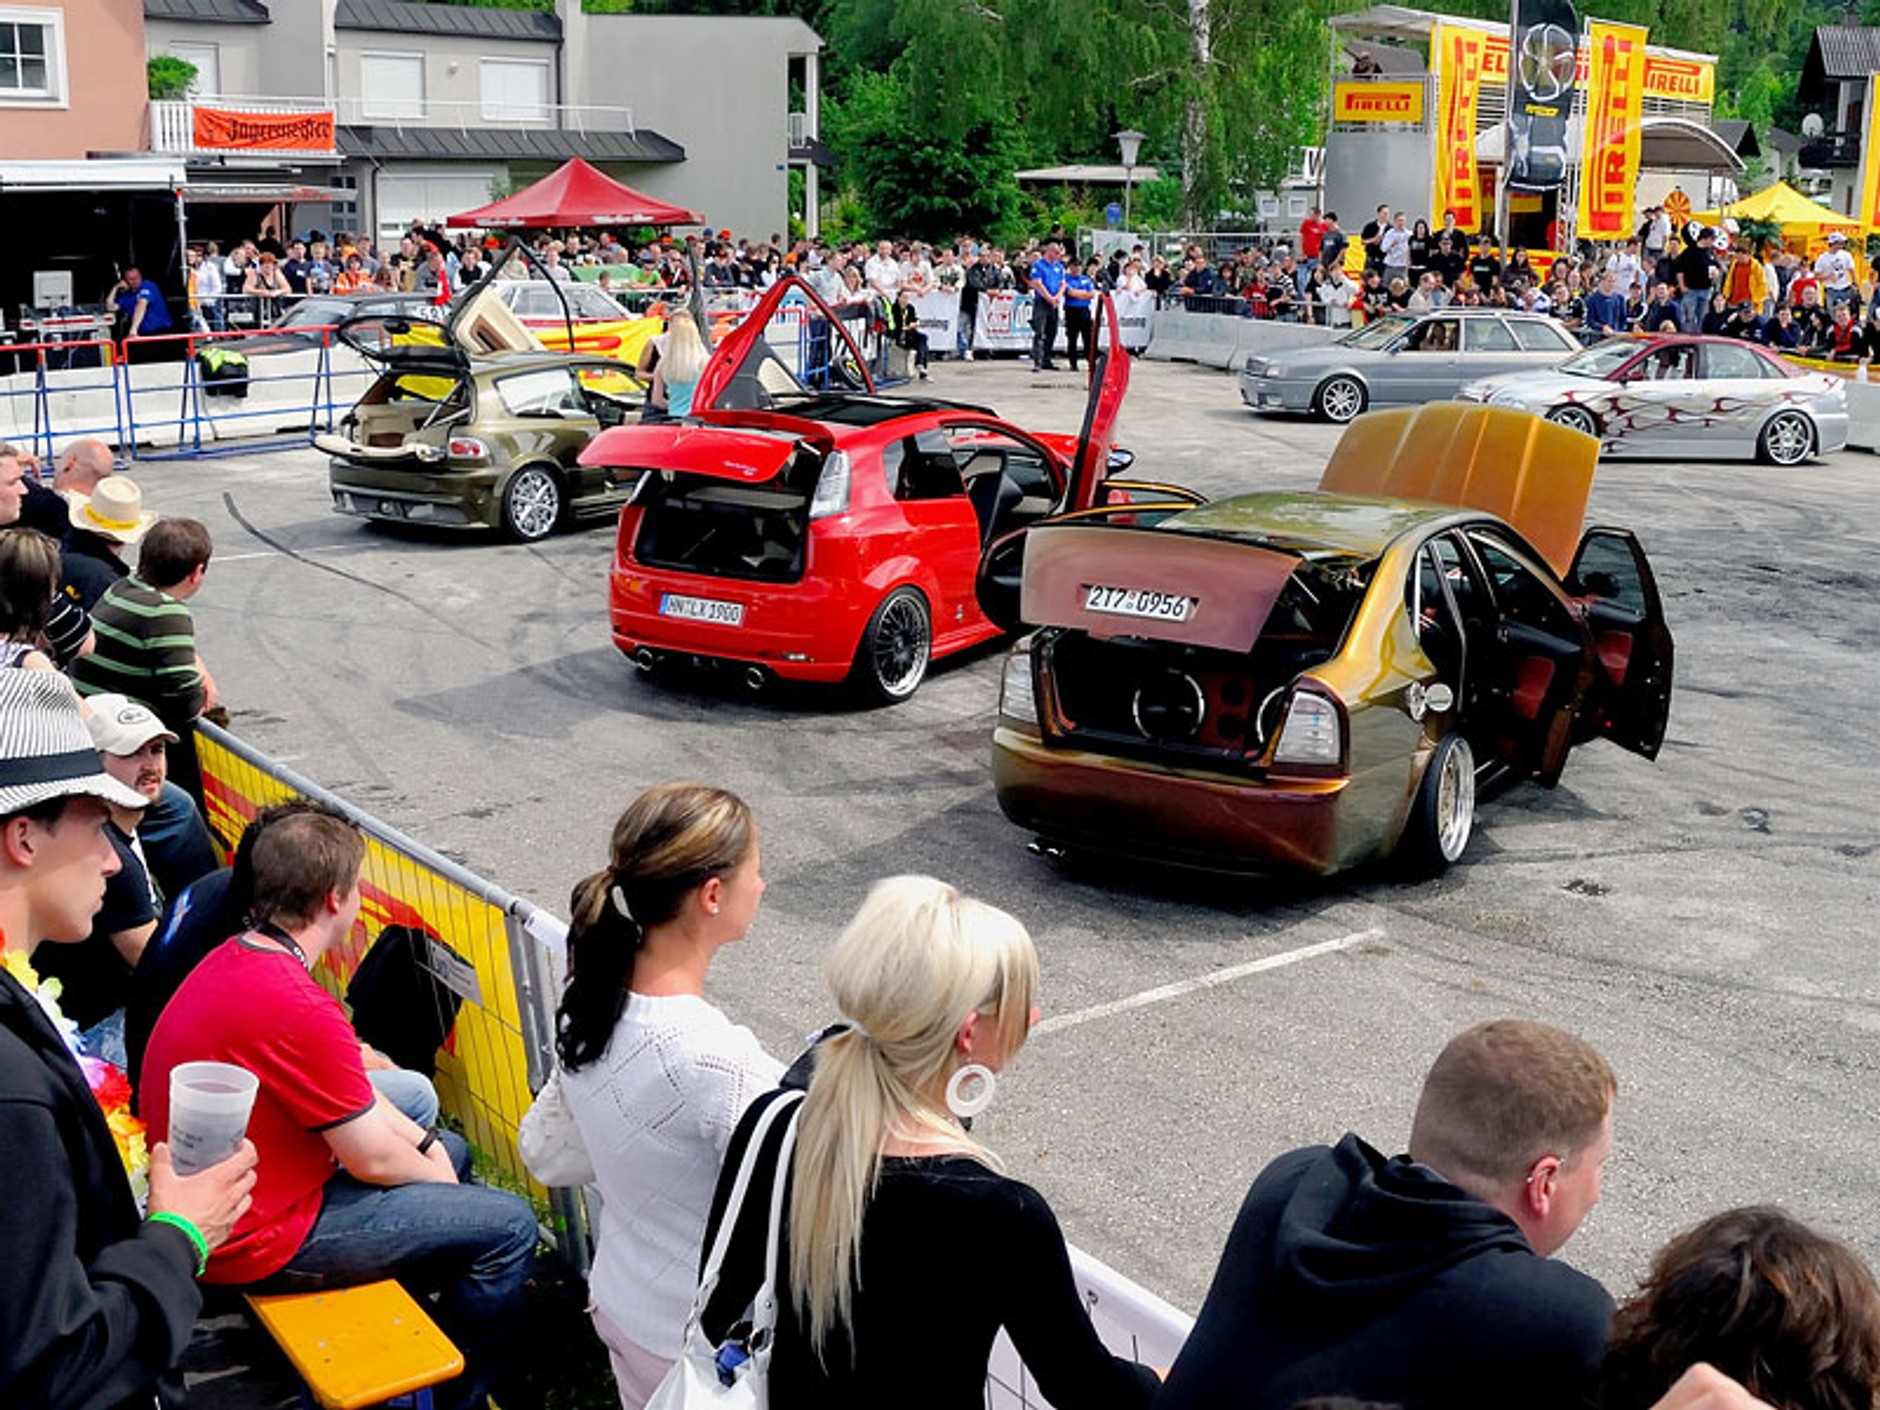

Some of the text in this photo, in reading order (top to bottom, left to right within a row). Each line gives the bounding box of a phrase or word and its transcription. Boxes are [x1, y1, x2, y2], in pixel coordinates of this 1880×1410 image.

[1643, 57, 1701, 95] PIRELLI
[1345, 93, 1411, 111] PIRELLI
[1446, 36, 1478, 226] PIRELLI
[1588, 34, 1632, 231] PIRELLI
[1089, 586, 1184, 617] 2T7 0956
